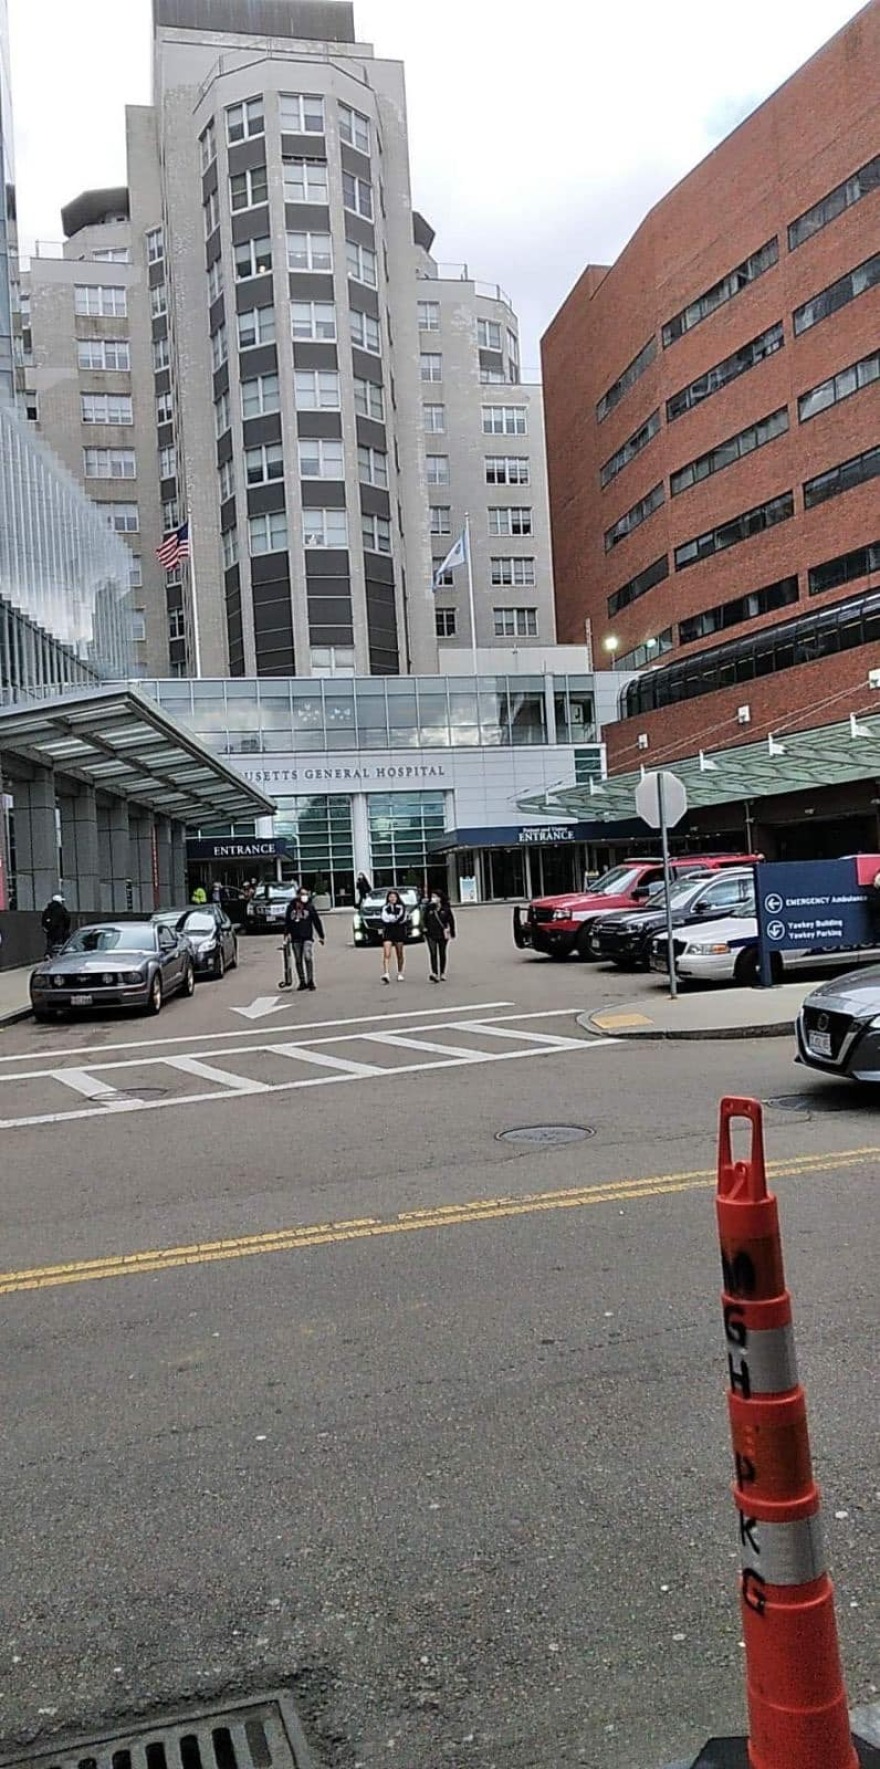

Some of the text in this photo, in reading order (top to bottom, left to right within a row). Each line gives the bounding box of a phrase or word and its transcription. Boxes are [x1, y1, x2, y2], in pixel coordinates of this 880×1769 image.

[305, 767, 370, 780] GENERAL
[377, 765, 446, 778] HOSPITAL
[518, 831, 575, 842] ENTRANCE
[213, 843, 276, 856] ENTRANCE
[786, 896, 830, 906] EMERGENCY
[787, 919, 843, 930] Yawkey Building
[788, 930, 843, 939] Yawkey Parking
